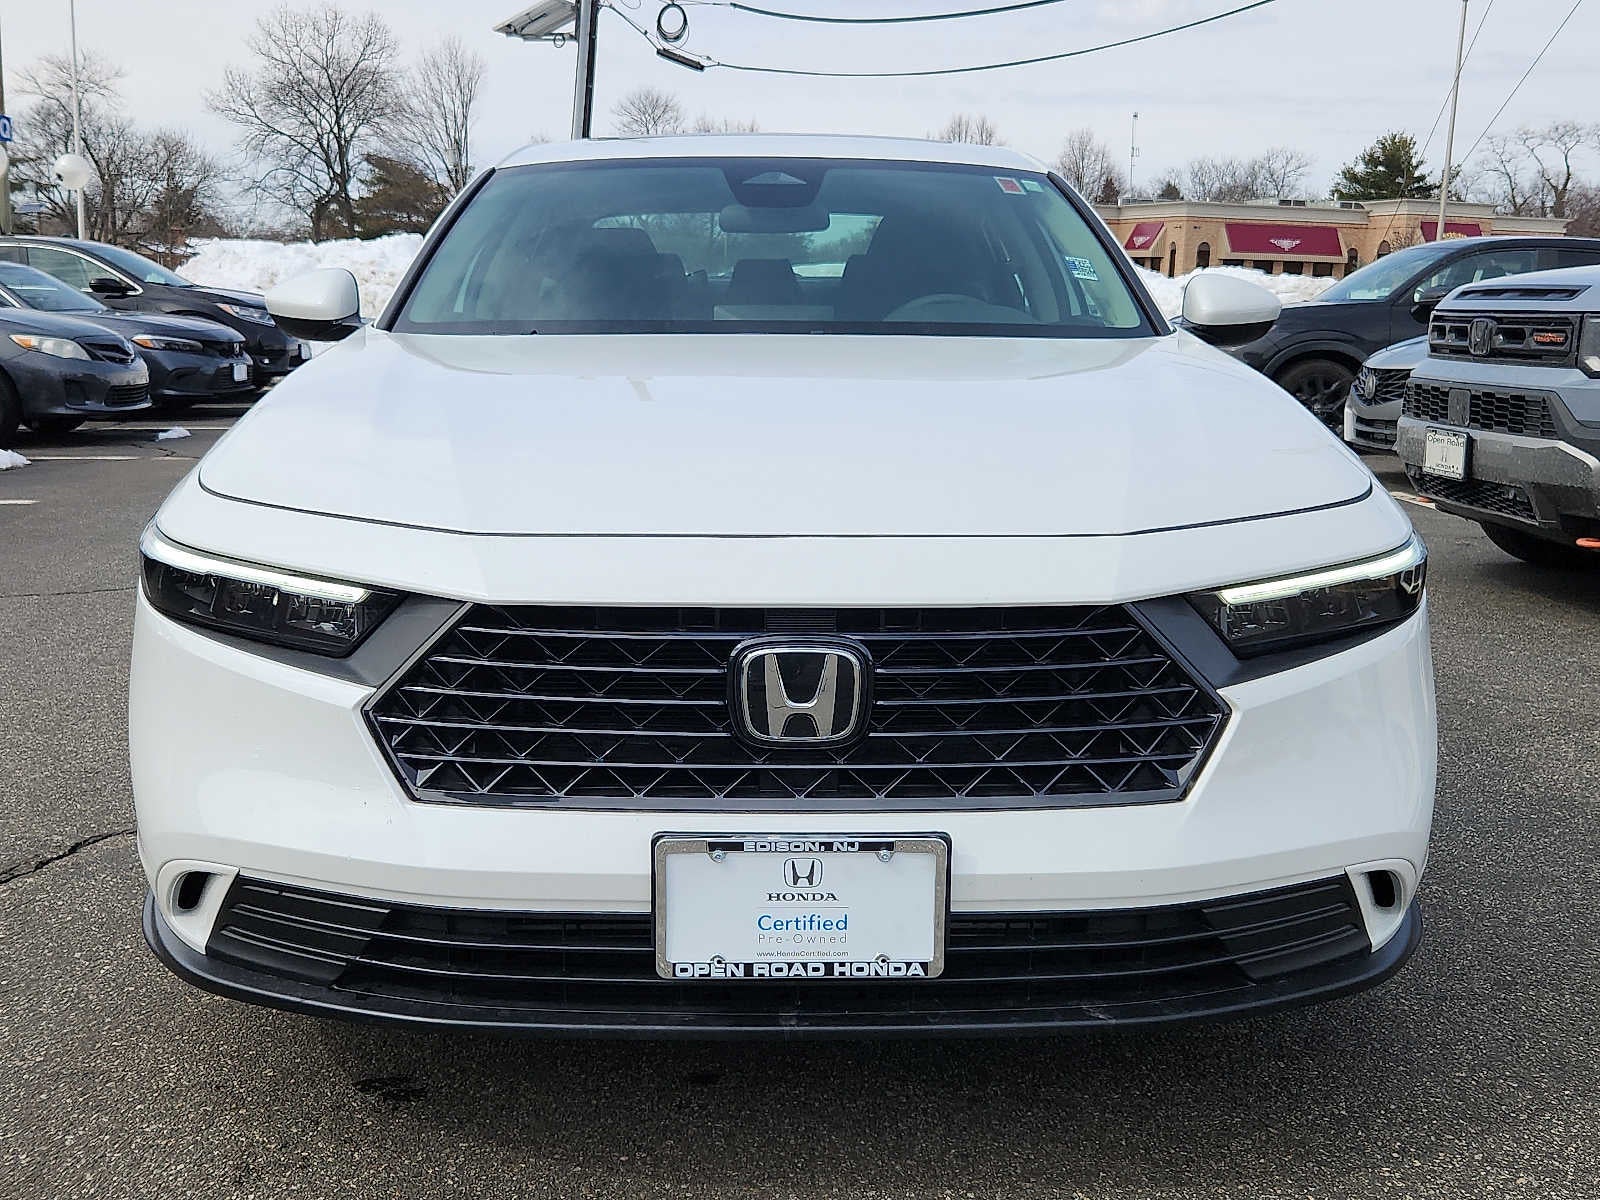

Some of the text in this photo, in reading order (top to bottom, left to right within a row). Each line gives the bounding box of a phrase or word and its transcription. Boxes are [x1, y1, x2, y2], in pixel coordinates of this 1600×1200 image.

[743, 841, 859, 852] EDISON, NJ
[767, 892, 837, 902] HONDA
[757, 914, 848, 931] Certified
[757, 933, 848, 944] Pre-Owned
[674, 963, 926, 977] OPEN ROAD HONDA
